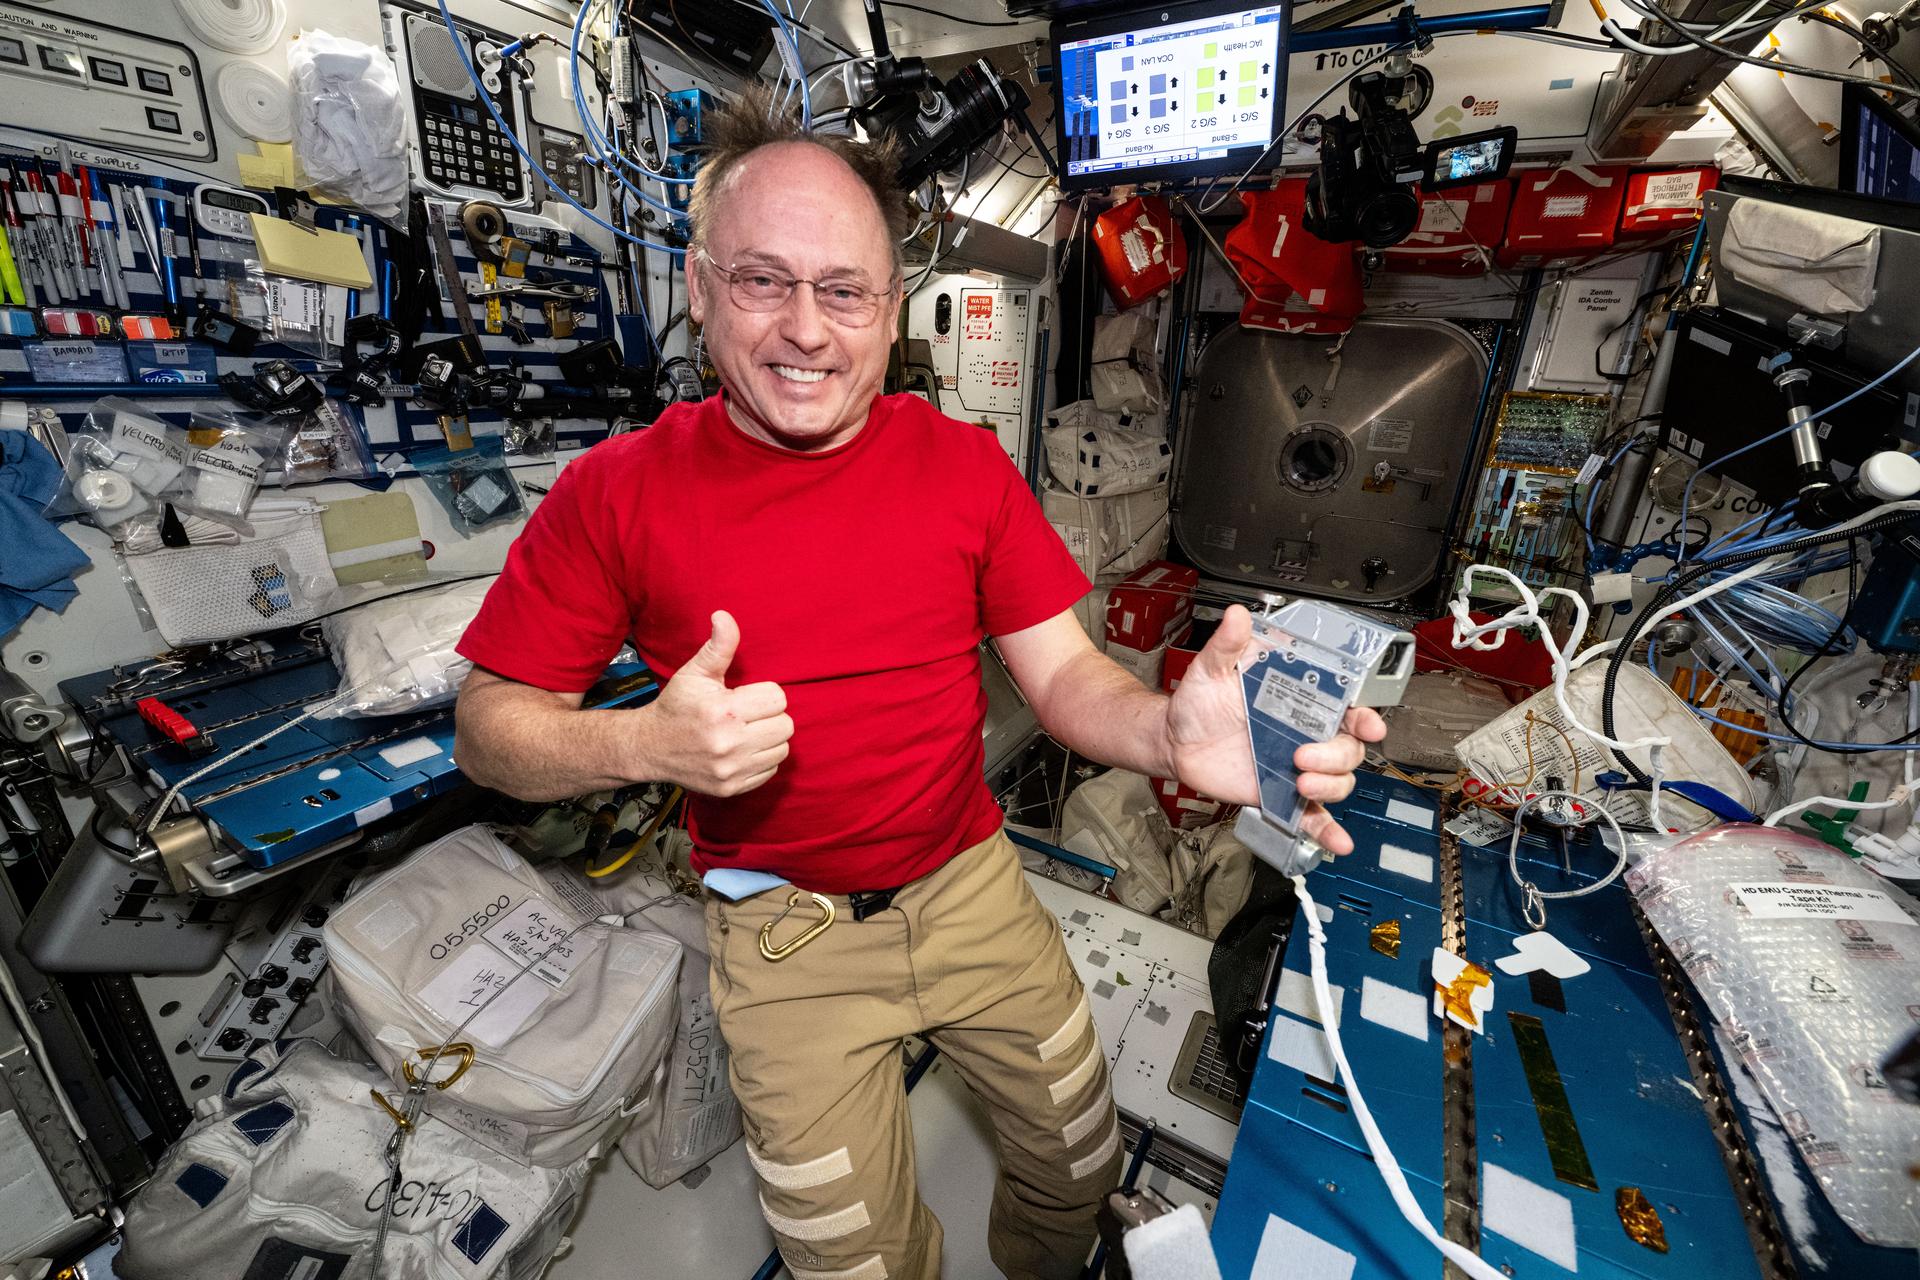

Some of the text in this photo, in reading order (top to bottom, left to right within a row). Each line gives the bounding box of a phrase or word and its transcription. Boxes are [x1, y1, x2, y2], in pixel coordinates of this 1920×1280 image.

[0, 12, 98, 41] CAUTION AND WARNING
[1223, 41, 1247, 52] Health
[1141, 57, 1156, 66] LAN
[1330, 50, 1348, 68] To
[1240, 111, 1259, 122] S/G
[1191, 117, 1217, 129] S/G 2
[1107, 128, 1132, 140] S/G 4
[1145, 123, 1170, 135] S/G 3
[1211, 132, 1238, 143] S-Band
[1125, 143, 1154, 153] Ku-Band
[43, 145, 141, 170] OFICE SUPPLIES
[1665, 176, 1682, 185] BAG
[1651, 182, 1694, 193] CARTRIDGE
[1653, 190, 1690, 201] AMMONIA
[1589, 288, 1613, 297] Zenith
[970, 297, 990, 305] WATER
[1577, 296, 1621, 305] IDA Control
[1586, 304, 1608, 313] Panel
[53, 346, 93, 357] BANDAID
[162, 348, 186, 357] QTIP
[1742, 886, 1757, 895] HD
[1758, 886, 1781, 895] EMU
[1782, 886, 1824, 897] Camera
[1824, 889, 1863, 899] Thermal
[1789, 895, 1814, 903] Tape
[430, 894, 510, 960] 0.5-5500
